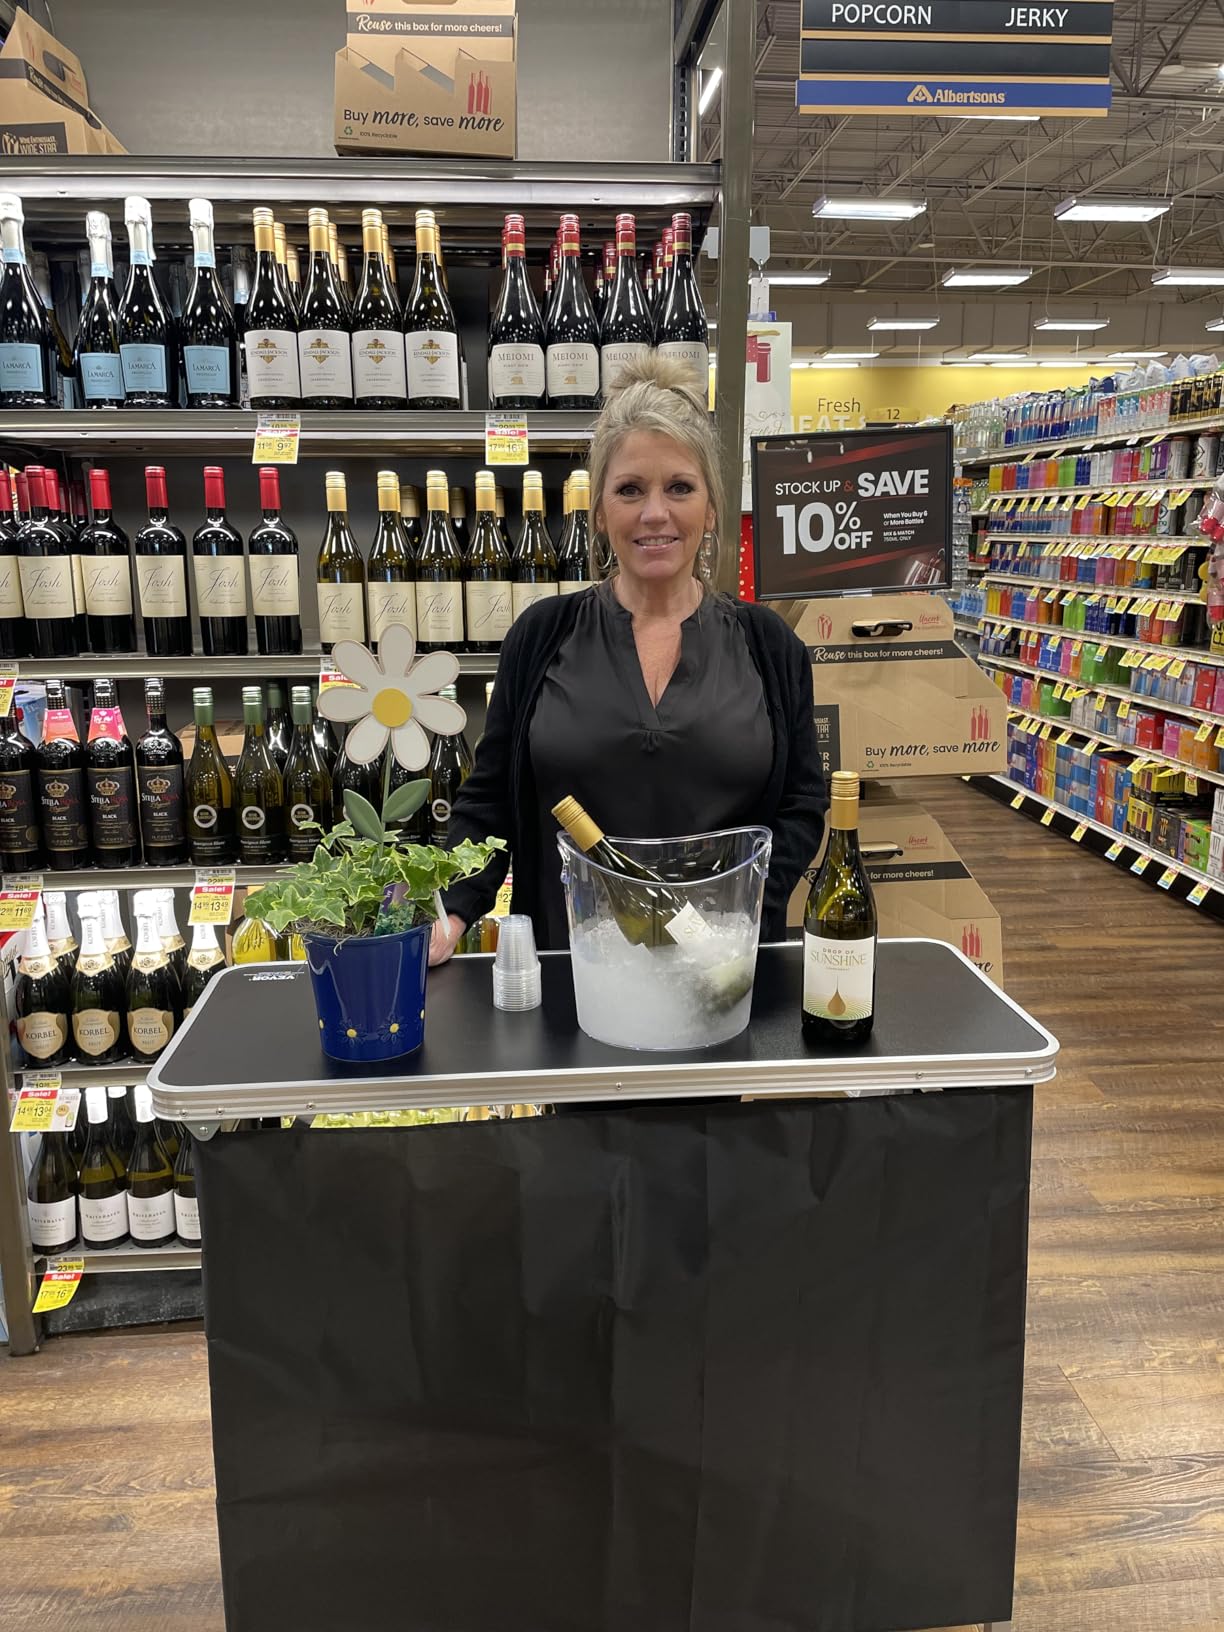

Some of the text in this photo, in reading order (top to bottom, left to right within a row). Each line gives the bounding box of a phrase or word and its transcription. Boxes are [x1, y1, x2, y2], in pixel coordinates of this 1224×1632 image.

[831, 4, 932, 25] POPCORN
[1005, 8, 1069, 27] JERKY
[356, 13, 502, 33] Reuse this box for more cheers!
[934, 87, 1005, 104] Albertsons
[344, 109, 505, 132] Buy more, save more
[498, 352, 534, 361] MEIOMI
[553, 352, 589, 361] MEIOMI
[818, 397, 861, 413] Fresh
[887, 408, 900, 420] 12
[776, 469, 929, 497] STOCK UP & SAVE
[883, 512, 900, 520] When
[900, 511, 911, 519] You
[911, 511, 923, 519] Buy
[833, 531, 874, 551] OFF
[813, 646, 944, 662] Reuse this box for more cheers!
[866, 740, 1001, 759] Buy more, save more
[870, 869, 934, 880] for more cheers!
[809, 950, 867, 966] SUNSHINE
[822, 947, 842, 955] DROP
[26, 1030, 58, 1040] KORBEL
[80, 1027, 110, 1036] KORBEL
[52, 1273, 76, 1281] Sale!
